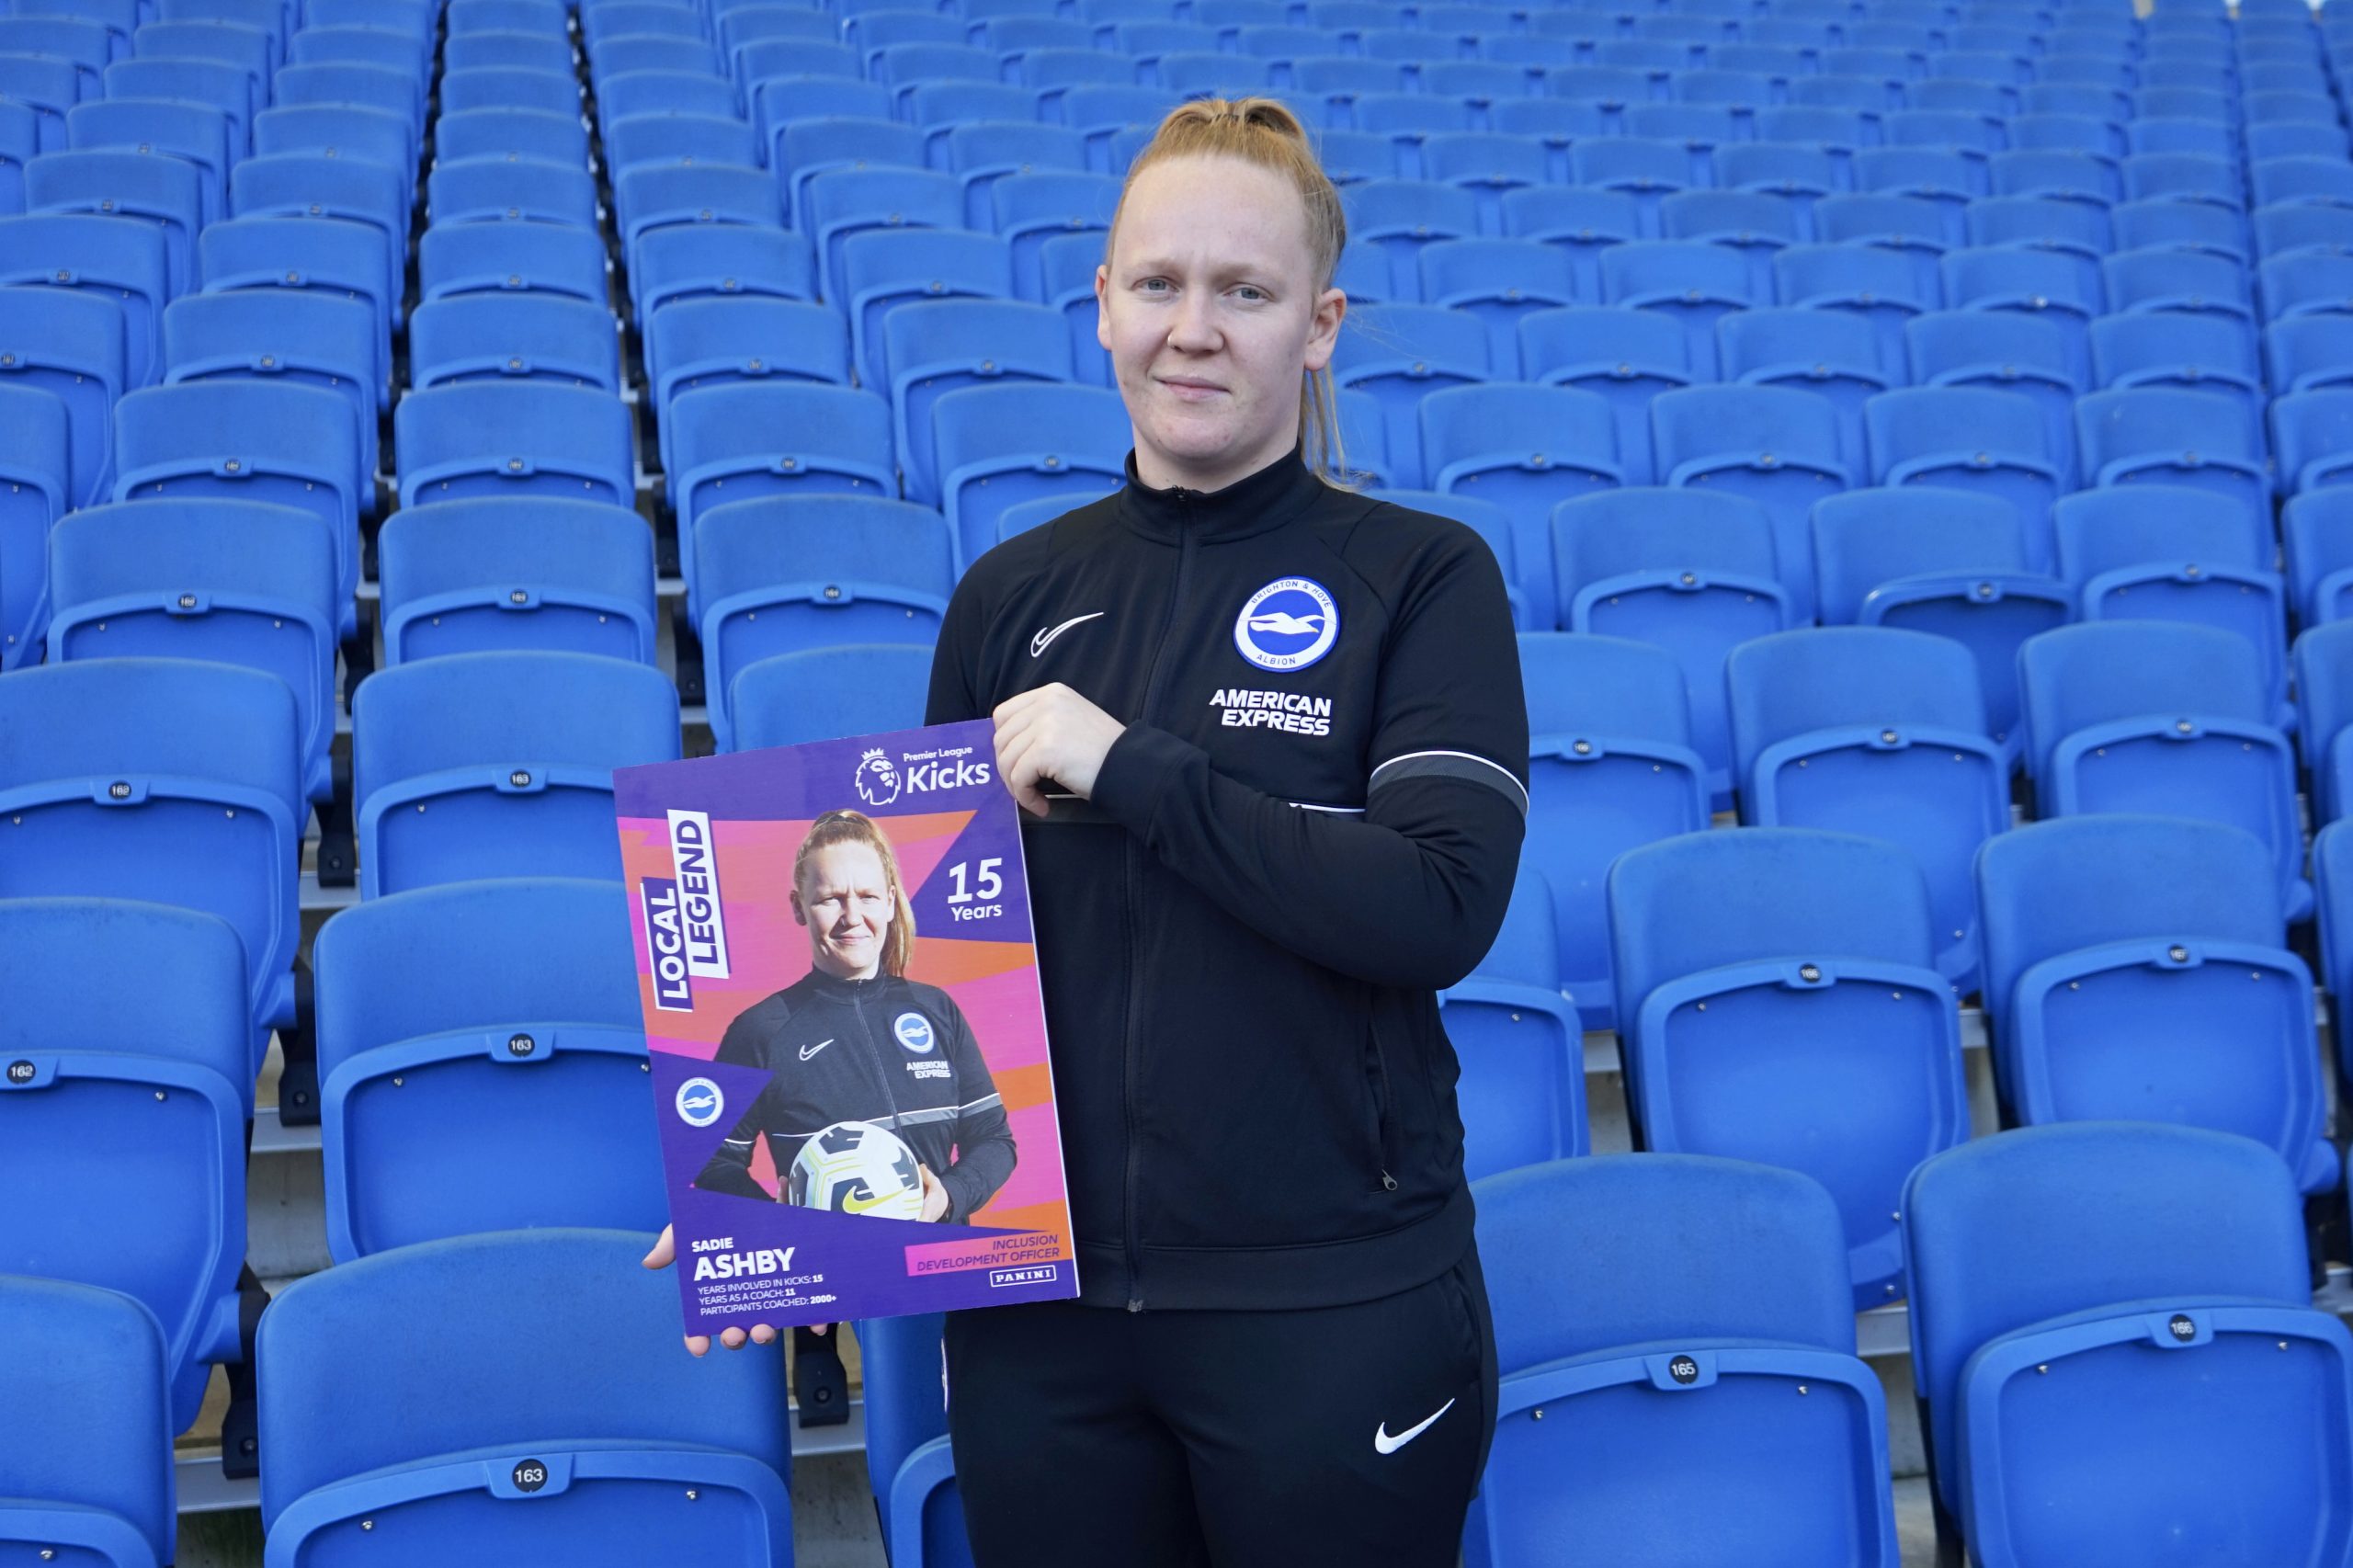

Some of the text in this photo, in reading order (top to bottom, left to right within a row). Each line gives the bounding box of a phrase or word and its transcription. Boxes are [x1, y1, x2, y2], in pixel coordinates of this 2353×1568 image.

[1251, 580, 1299, 604] BRIGHTON
[1312, 587, 1332, 608] HOVE
[1256, 653, 1296, 665] ALBION
[1209, 688, 1332, 717] AMERICAN
[1222, 709, 1331, 735] EXPRESS
[903, 746, 973, 762] Premier League
[906, 760, 991, 793] Kicks
[947, 858, 1003, 903] 15
[676, 820, 719, 964] LEGEND
[950, 903, 1002, 922] Years
[650, 887, 688, 999] LOCAL
[510, 1039, 531, 1051] 163
[10, 1065, 33, 1077] 162
[691, 1237, 733, 1252] SADIE
[993, 1234, 1058, 1251] INCLUSION
[693, 1246, 795, 1281] ASHBY
[917, 1247, 1060, 1272] DEVELOPMENT OFFICER
[698, 1274, 824, 1295] YEARS INVOLVED IN KICKS: 15
[995, 1269, 1051, 1283] PANINI
[699, 1288, 796, 1305] YEARS AS A COACH: 11
[700, 1294, 837, 1316] PARTICIPANTS COACHED: 2000+
[2170, 1321, 2193, 1335] 166
[1671, 1362, 1696, 1376] 165
[515, 1468, 543, 1483] 163
